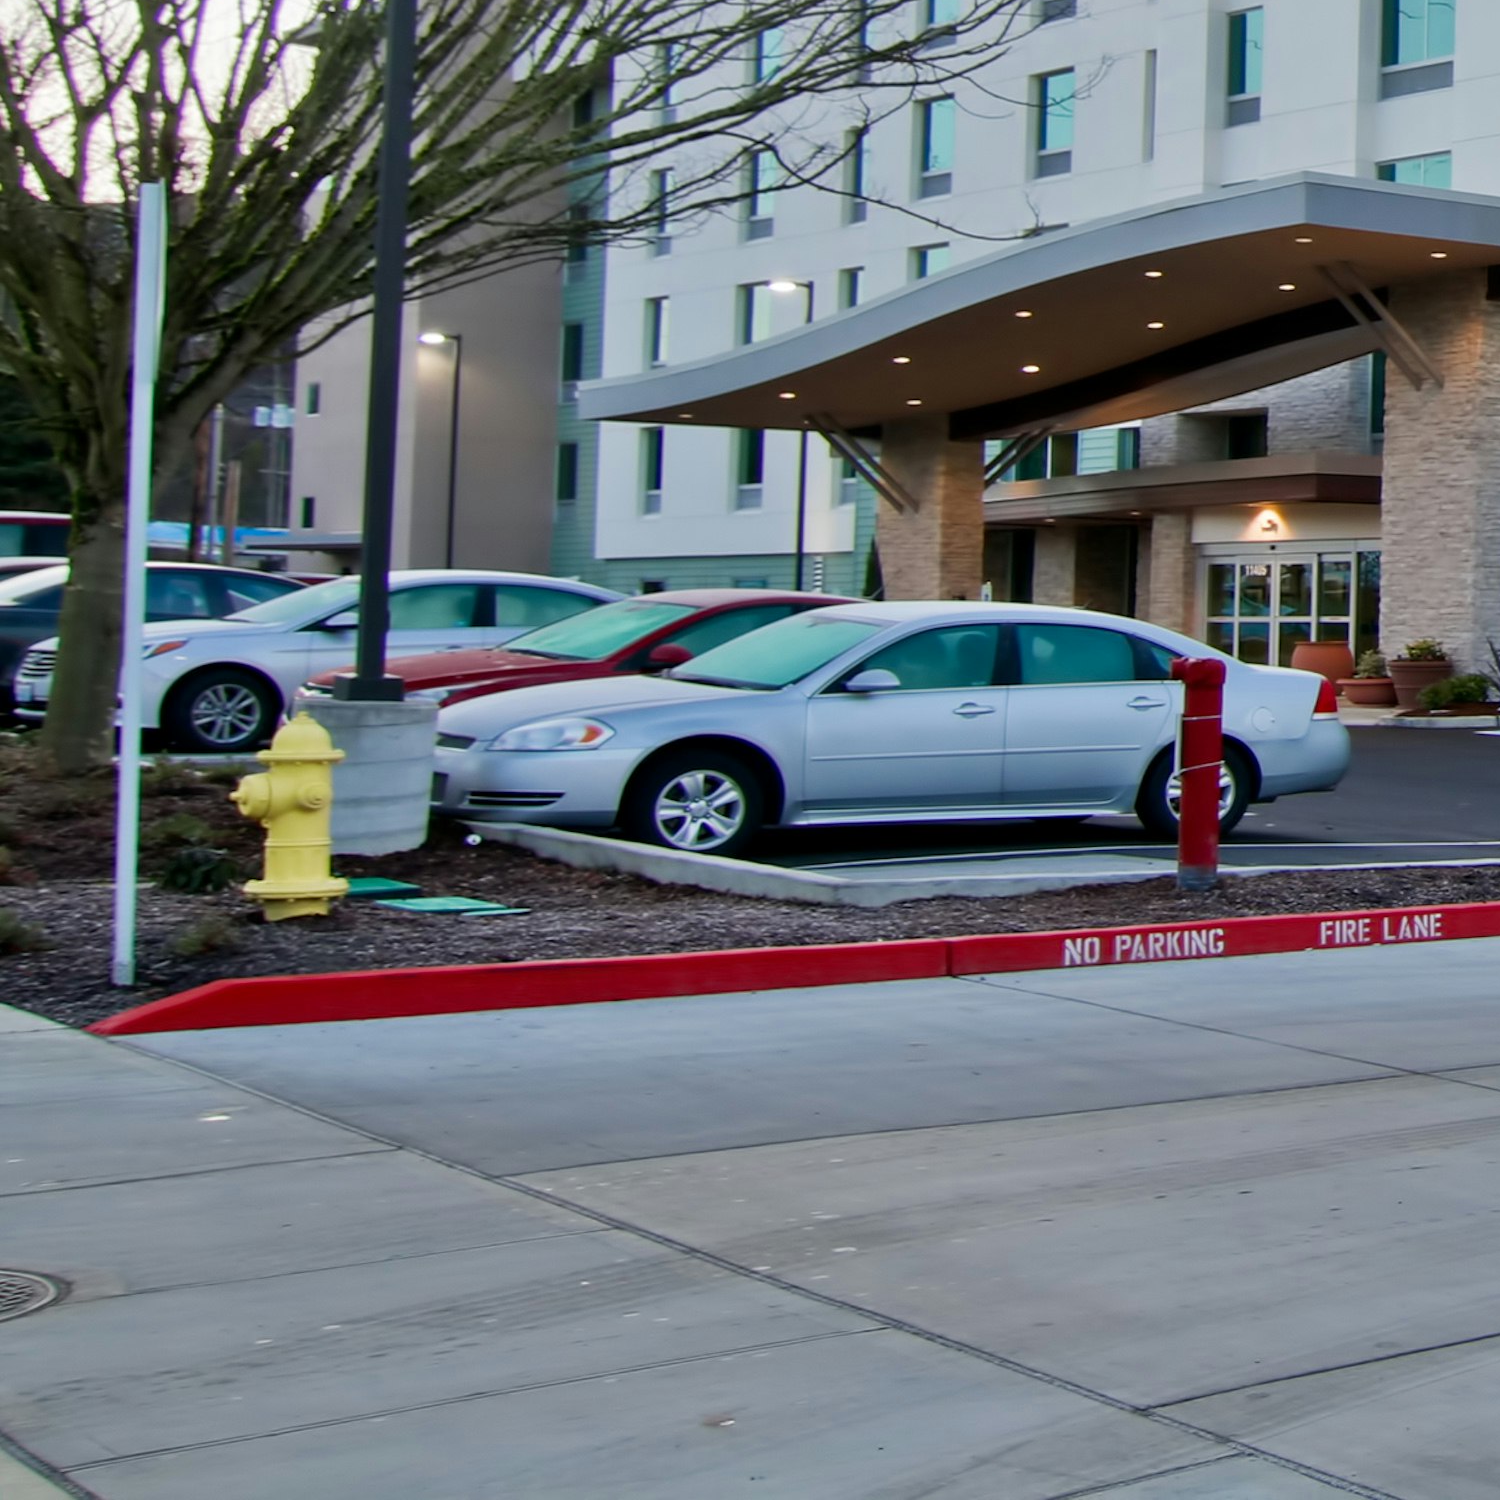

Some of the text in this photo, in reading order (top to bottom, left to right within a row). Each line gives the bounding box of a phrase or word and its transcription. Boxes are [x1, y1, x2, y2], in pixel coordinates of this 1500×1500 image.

[1063, 912, 1442, 967] NO PARKING FIRE LANE
